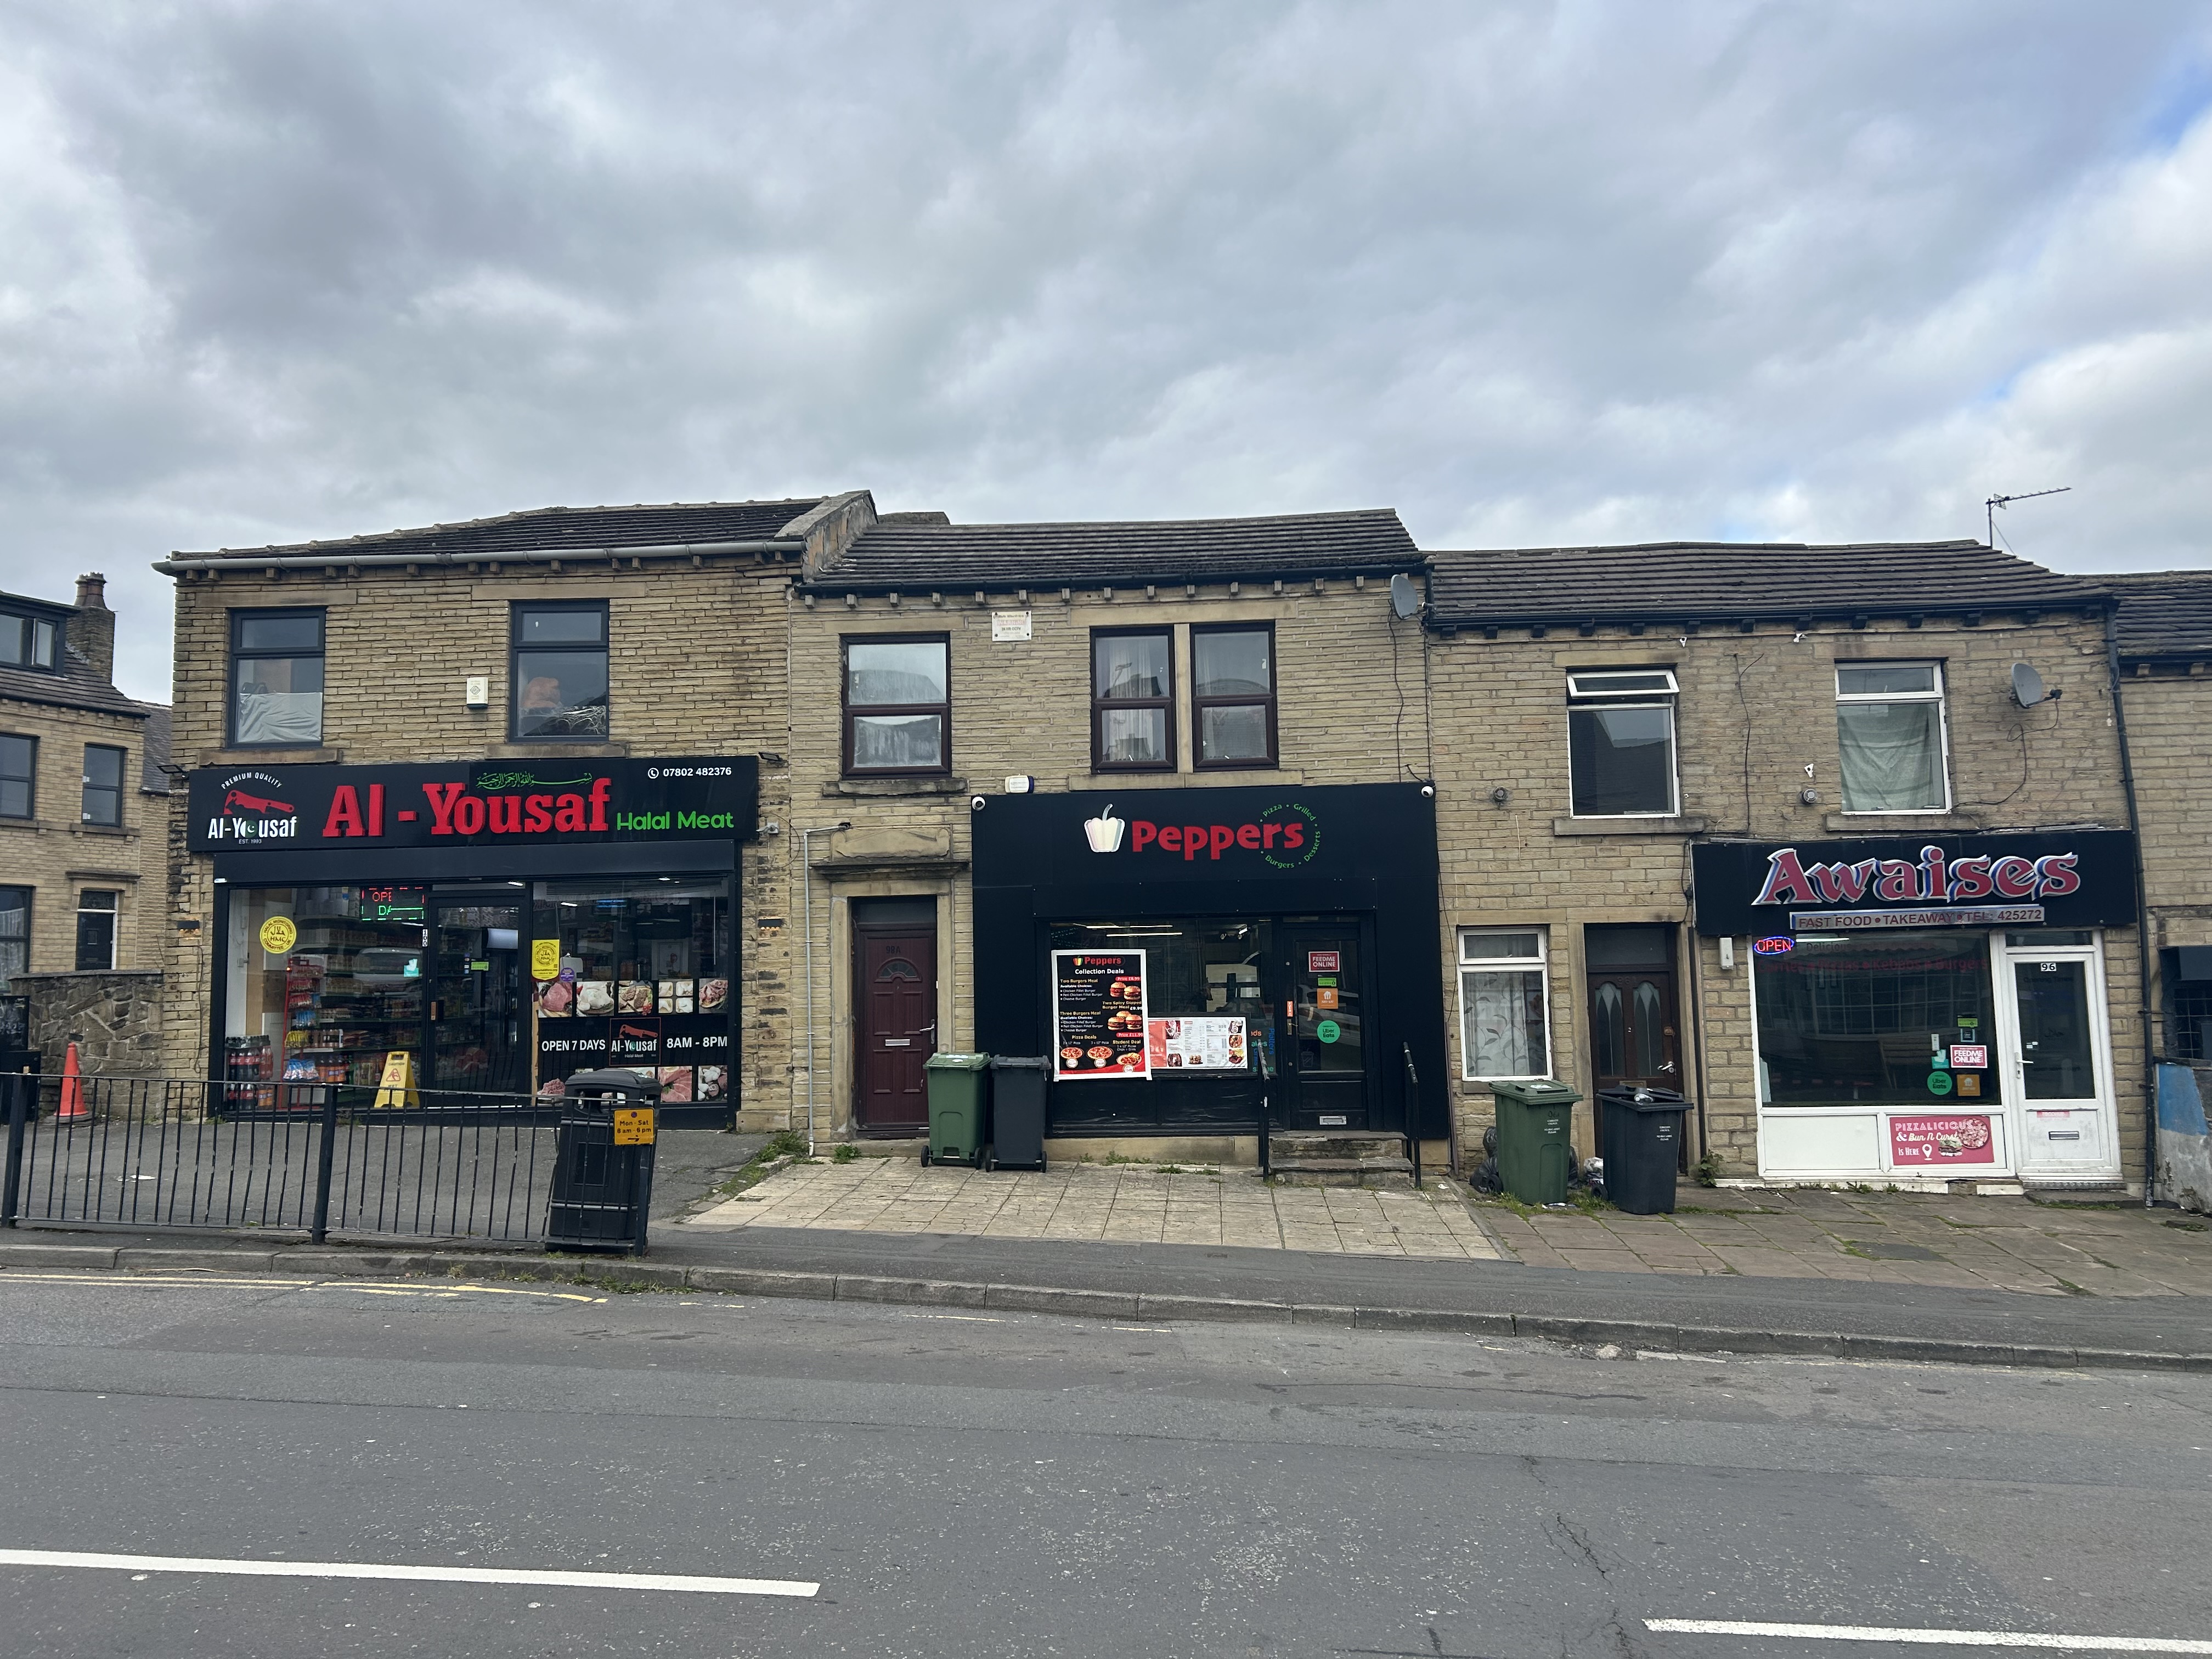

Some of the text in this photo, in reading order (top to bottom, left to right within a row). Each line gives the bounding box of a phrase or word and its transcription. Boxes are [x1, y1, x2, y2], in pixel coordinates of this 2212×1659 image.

[663, 768, 732, 777] 07802 482376
[221, 772, 283, 789] PREMIUM QUALITY
[322, 783, 385, 838] Al
[422, 777, 612, 835] Yousaf
[1294, 804, 1316, 821] Grilled
[617, 811, 734, 831] Halal Meat
[1132, 820, 1305, 860] Peppers
[1304, 831, 1321, 861] Desserts
[1265, 855, 1294, 868] Burgers
[1751, 845, 2081, 905] Awaises
[1798, 917, 1831, 928] FAST
[1835, 915, 1871, 927] FOOD
[1882, 913, 1955, 925] TAKEAWAY
[1997, 909, 2042, 920] 425272
[1757, 939, 1792, 952] OPEN
[1085, 956, 1122, 966] Peppers
[541, 1040, 606, 1052] OPEN 7 DAYS
[667, 1037, 692, 1048] 8AM
[703, 1036, 728, 1048] 8PM
[1895, 1121, 1974, 1131] PIZZALICIOUS
[1896, 1132, 1908, 1142] &
[1908, 1133, 1926, 1142] Bun
